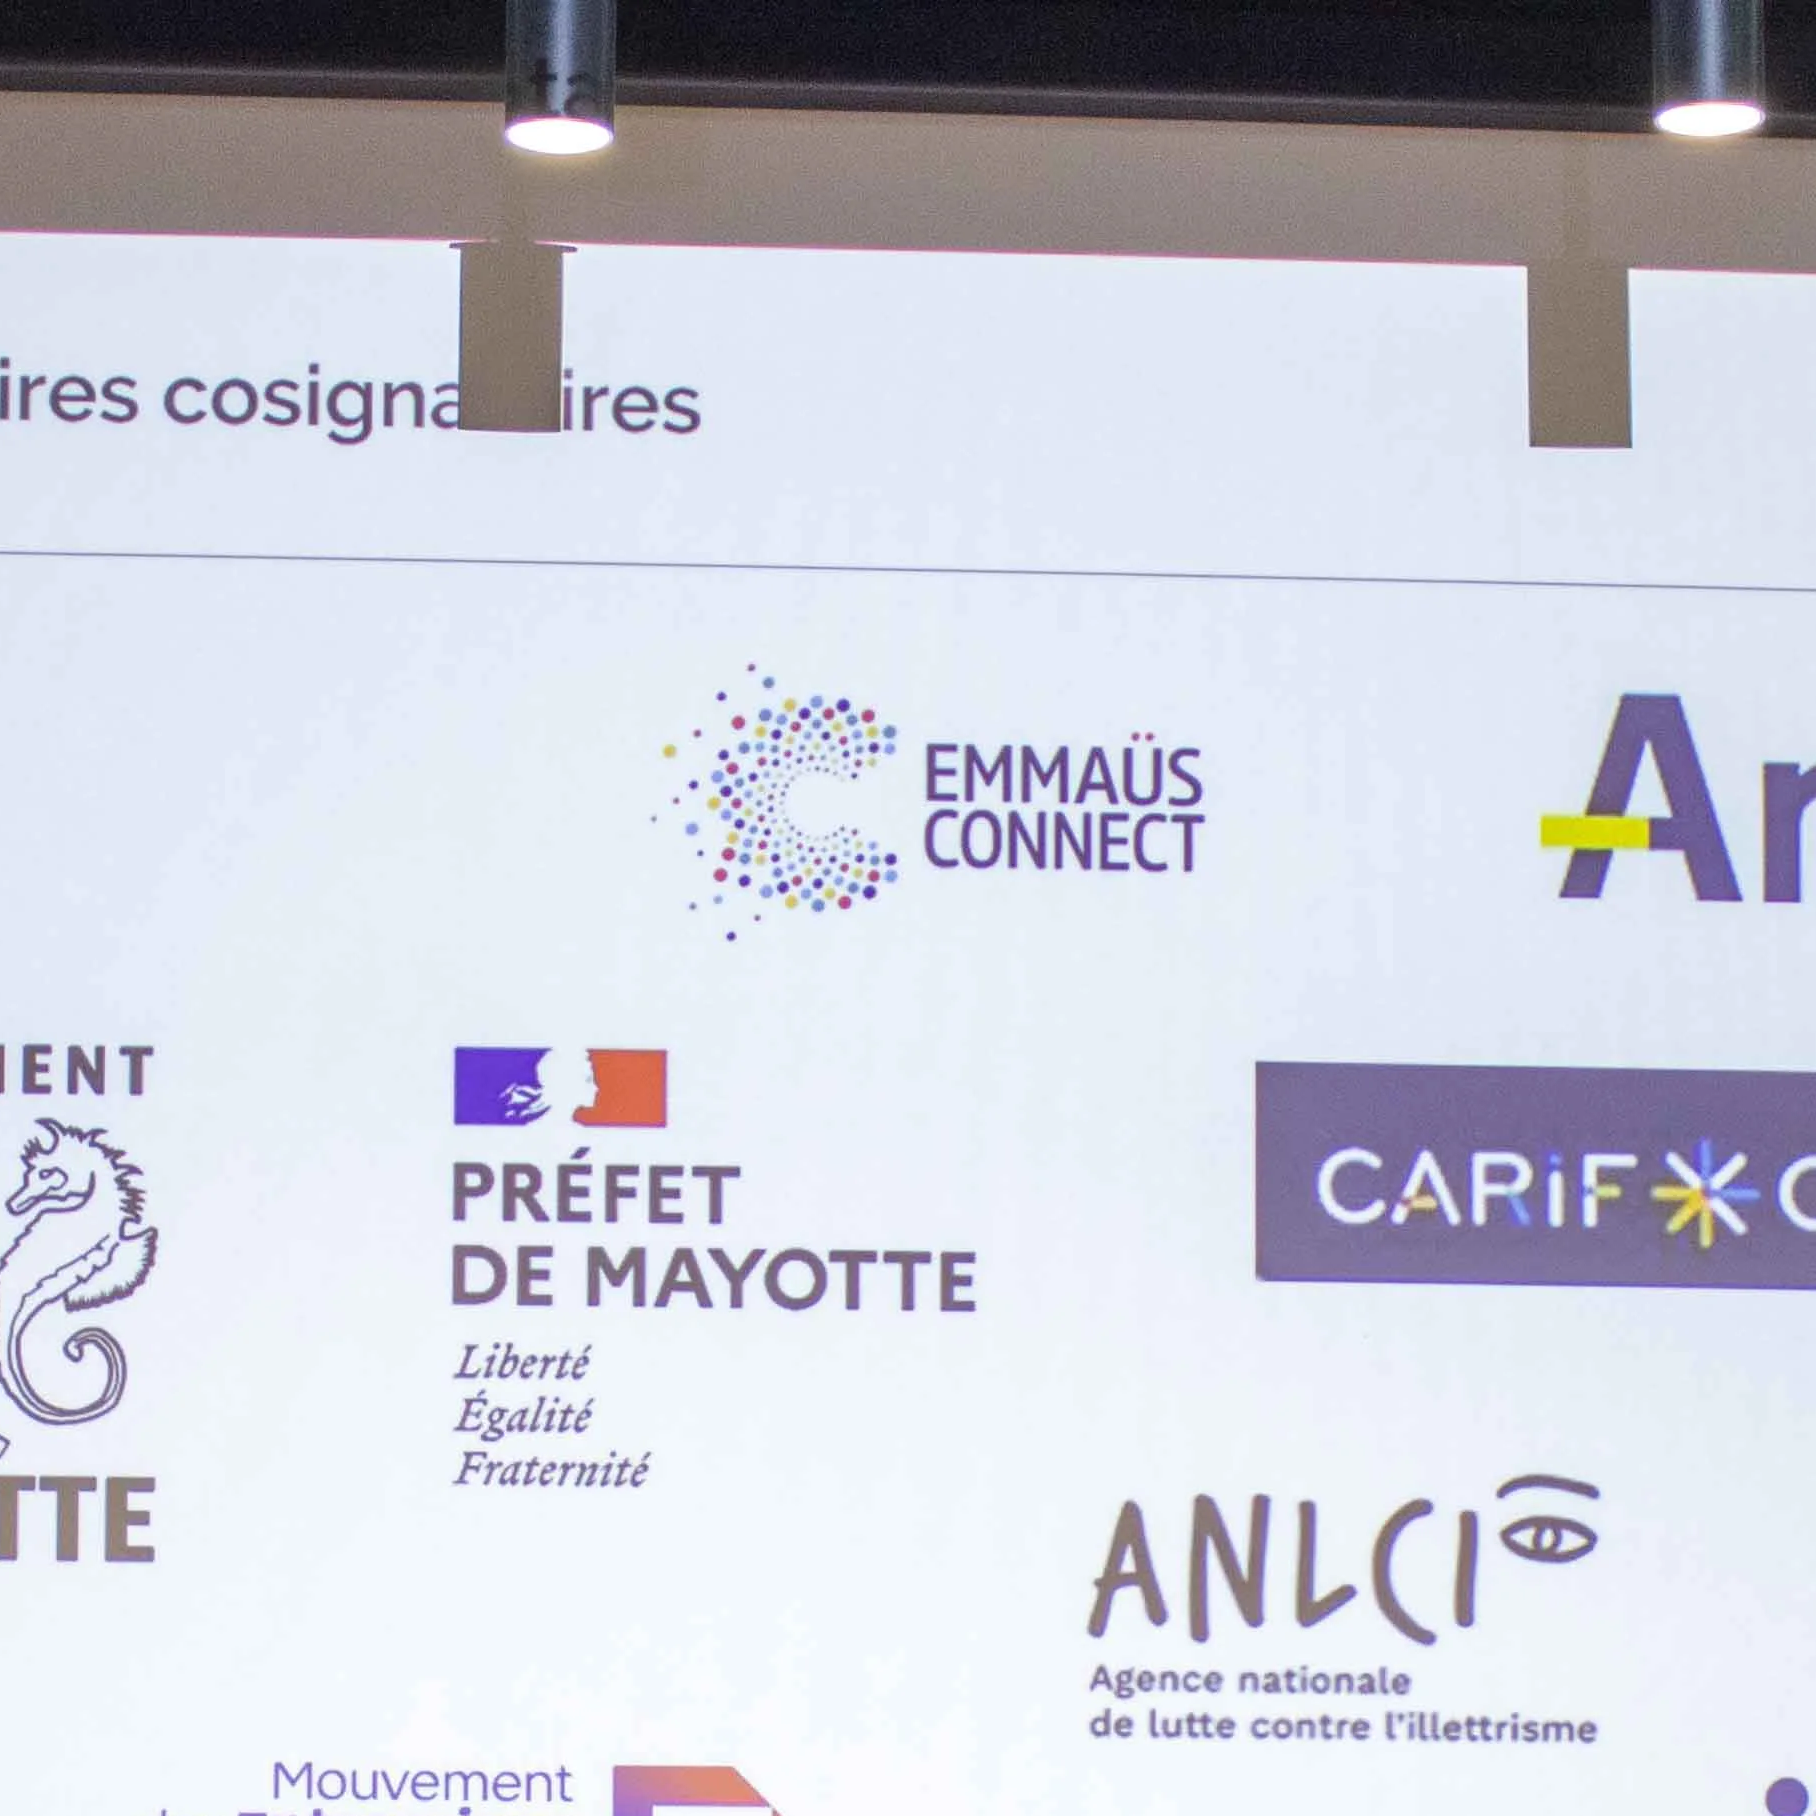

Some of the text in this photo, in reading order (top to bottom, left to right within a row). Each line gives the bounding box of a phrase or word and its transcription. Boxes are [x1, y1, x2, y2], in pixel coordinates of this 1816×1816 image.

[163, 362, 702, 446] cosignaires
[927, 733, 1202, 807] EMMAÜS
[925, 809, 1205, 872] CONNECT
[453, 1147, 741, 1224] PRÉFET
[452, 1245, 976, 1312] DE MAYOTTE
[454, 1343, 591, 1380] Liberté
[454, 1390, 593, 1442] Égalité
[453, 1451, 651, 1487] Fraternité
[1088, 1494, 1478, 1646] ANLCI
[1090, 1665, 1411, 1699] Agence nationale
[1090, 1708, 1597, 1743] de lutte contre l'illettrisme
[274, 1762, 572, 1802] Mouvement
